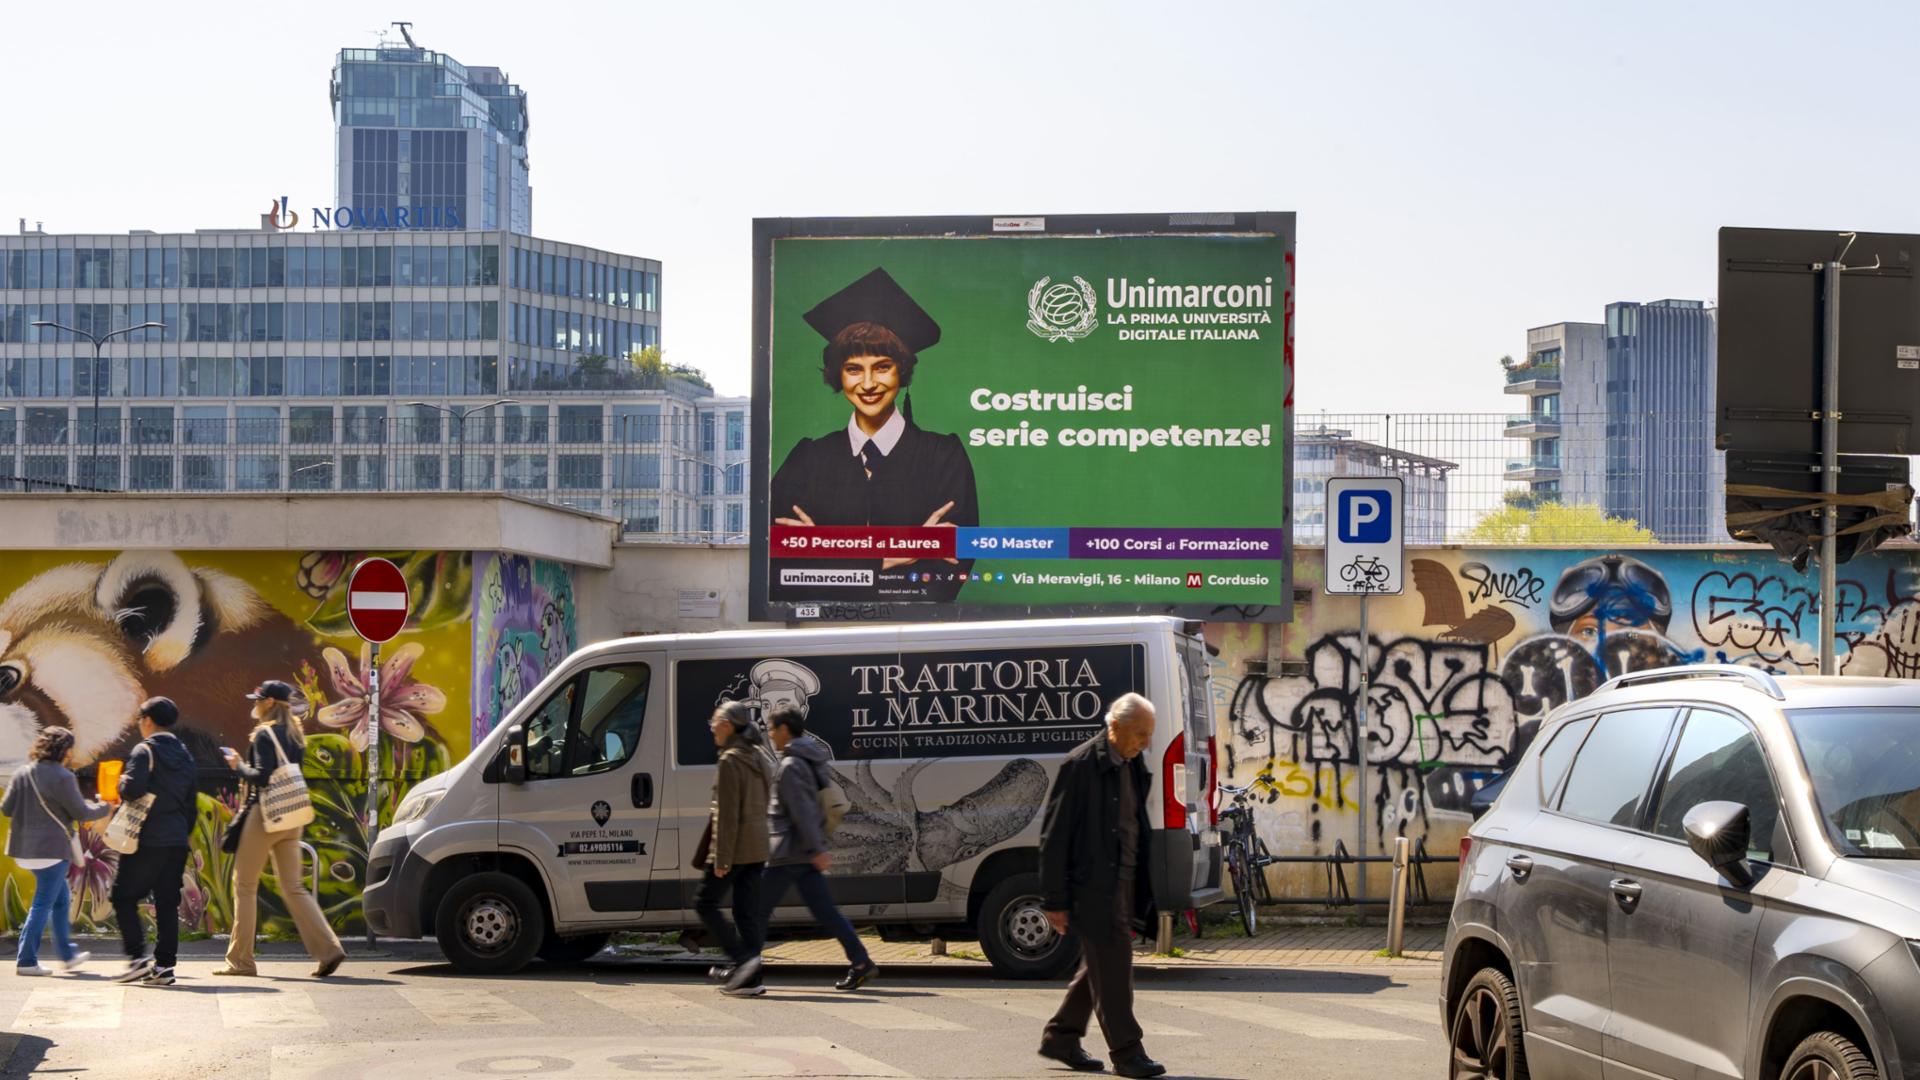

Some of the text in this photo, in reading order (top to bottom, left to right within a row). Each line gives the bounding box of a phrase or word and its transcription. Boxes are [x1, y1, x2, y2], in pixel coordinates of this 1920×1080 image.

[312, 207, 460, 229] NOVARTIS
[1107, 277, 1272, 308] Unimarconi
[1107, 310, 1272, 324] LA PRIMA UNIVERSITÀ
[1119, 329, 1260, 341] DIGITALE ITALIANA
[970, 385, 1133, 411] Costruisci
[969, 421, 1271, 452] serie competenze!
[1349, 495, 1380, 537] P
[781, 537, 940, 549] +50 Percorsi di Laurea
[971, 537, 1054, 549] +50 Master
[1086, 538, 1270, 551] +100 Corsi di Formazione
[783, 572, 871, 584] unimarconi.it
[1012, 574, 1034, 585] Via
[1038, 574, 1104, 587] Meravigli,
[1108, 574, 1122, 585] 16
[1135, 574, 1181, 586] Milano
[1208, 575, 1269, 586] Cordusio
[852, 659, 1101, 694] TRATTORIA
[851, 690, 1101, 727] IL MARINAIO
[852, 736, 908, 748] CUCINA
[915, 732, 1026, 746] TRADIZIONALE
[582, 830, 597, 838] PEPE
[609, 829, 633, 838] MILANO
